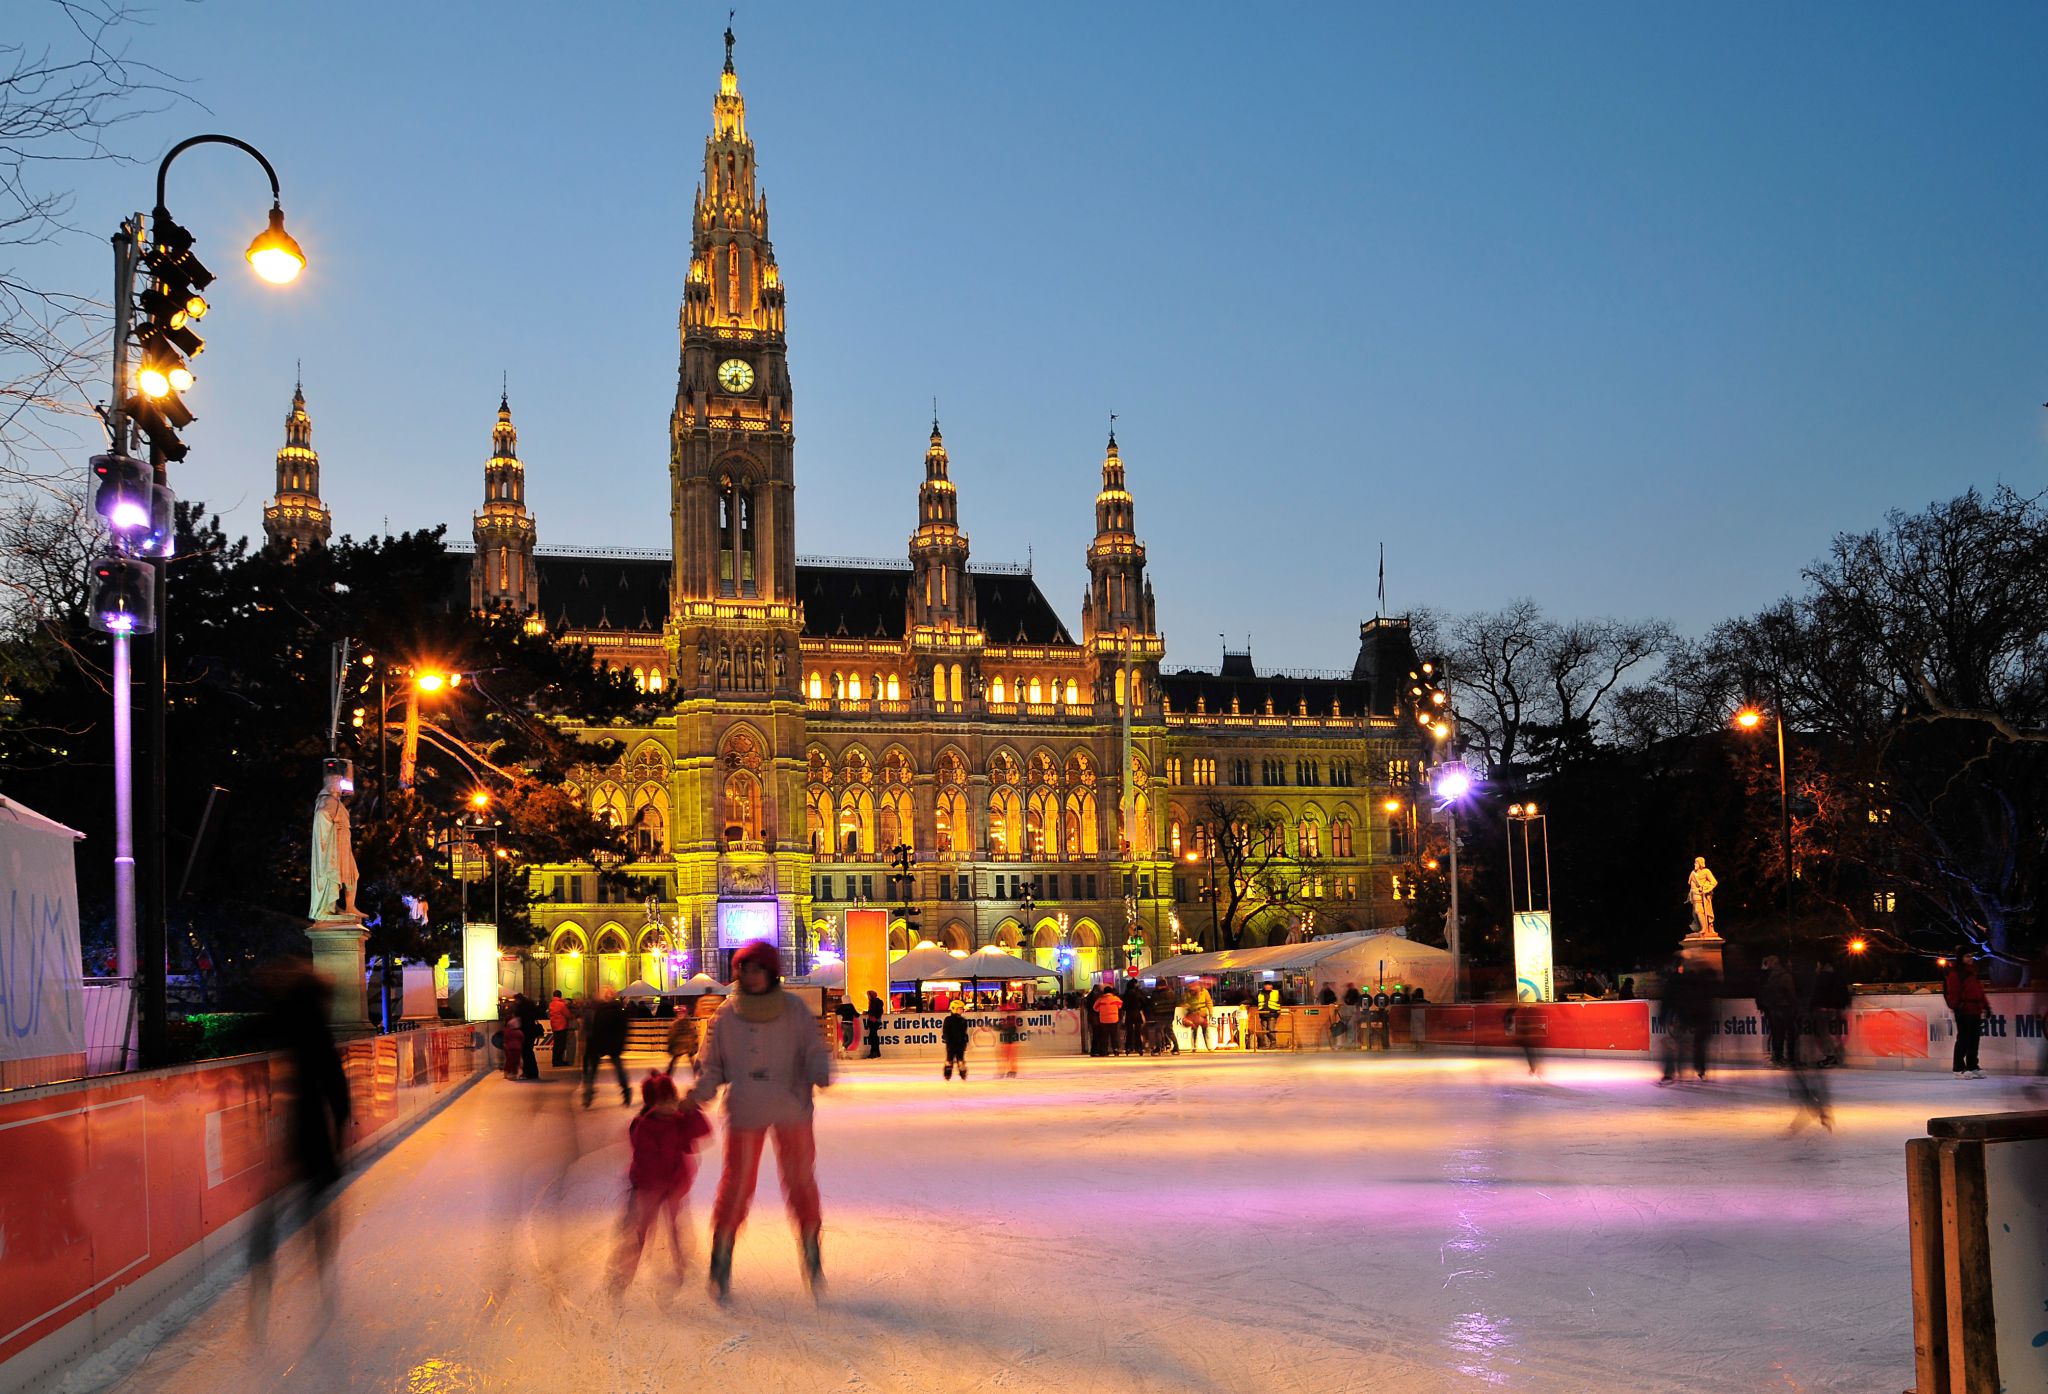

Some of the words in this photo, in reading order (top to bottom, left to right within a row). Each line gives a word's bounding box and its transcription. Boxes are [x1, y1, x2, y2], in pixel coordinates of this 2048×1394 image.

[894, 1017, 942, 1029] direkte
[1028, 1014, 1055, 1027] will,
[1724, 1016, 1757, 1035] statt
[905, 1033, 937, 1044] auch
